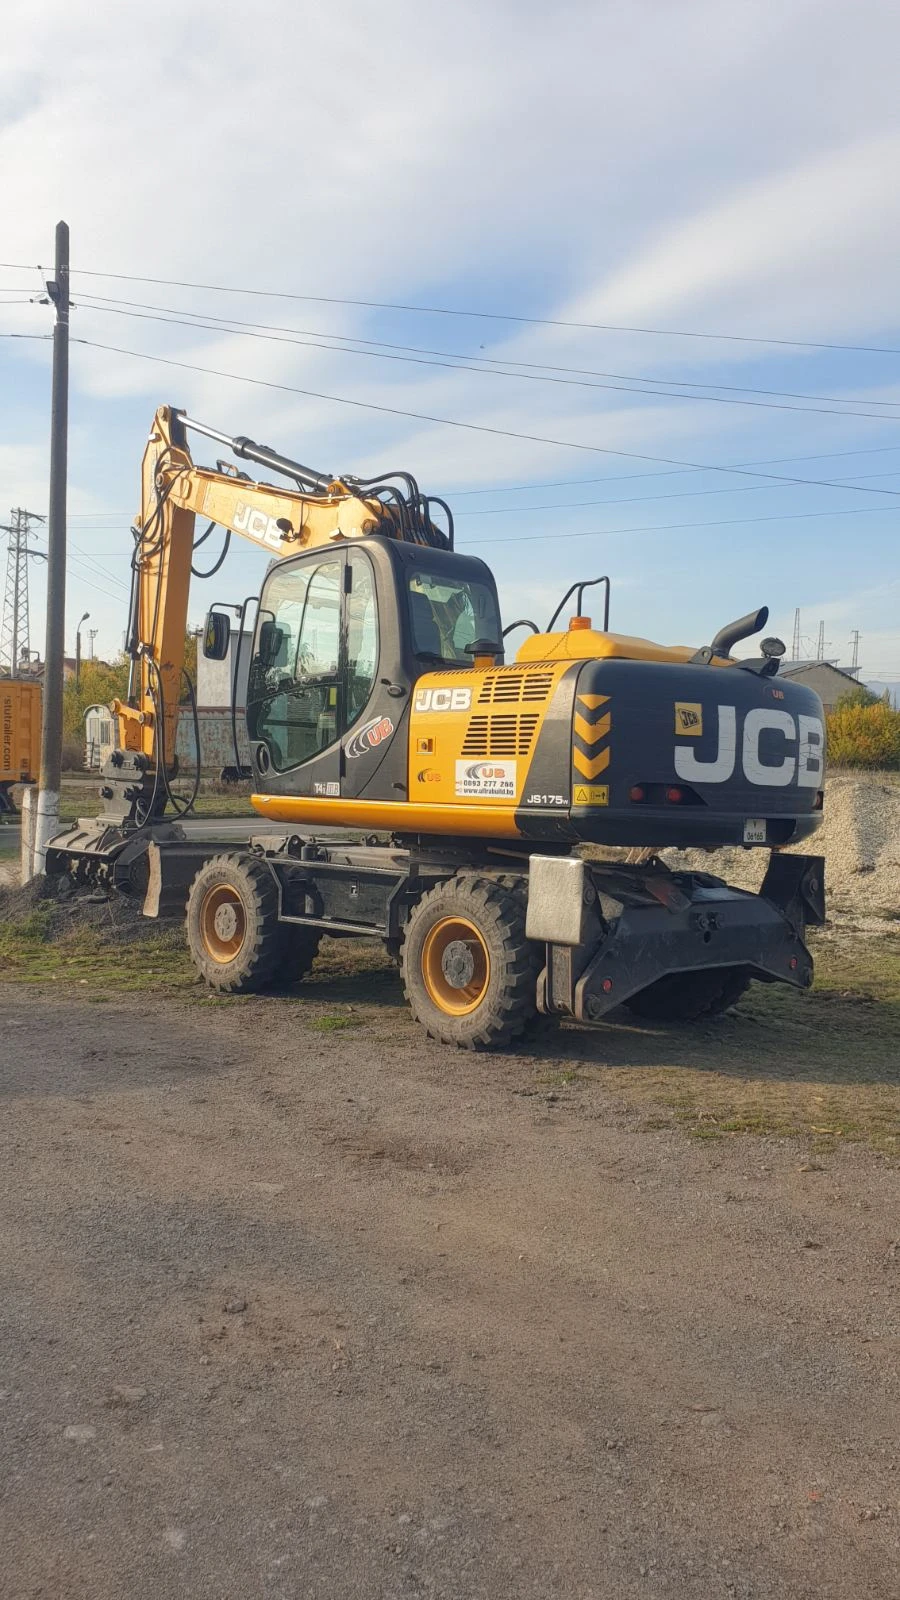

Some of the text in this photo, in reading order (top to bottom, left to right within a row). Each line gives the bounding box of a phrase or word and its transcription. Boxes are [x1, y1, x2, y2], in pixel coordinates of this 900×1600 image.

[233, 502, 285, 549] JCB
[415, 688, 472, 711] JCB
[772, 689, 785, 699] UB
[681, 710, 698, 727] JCB
[367, 717, 394, 746] UB
[674, 705, 823, 788] JCB
[482, 768, 505, 778] UB
